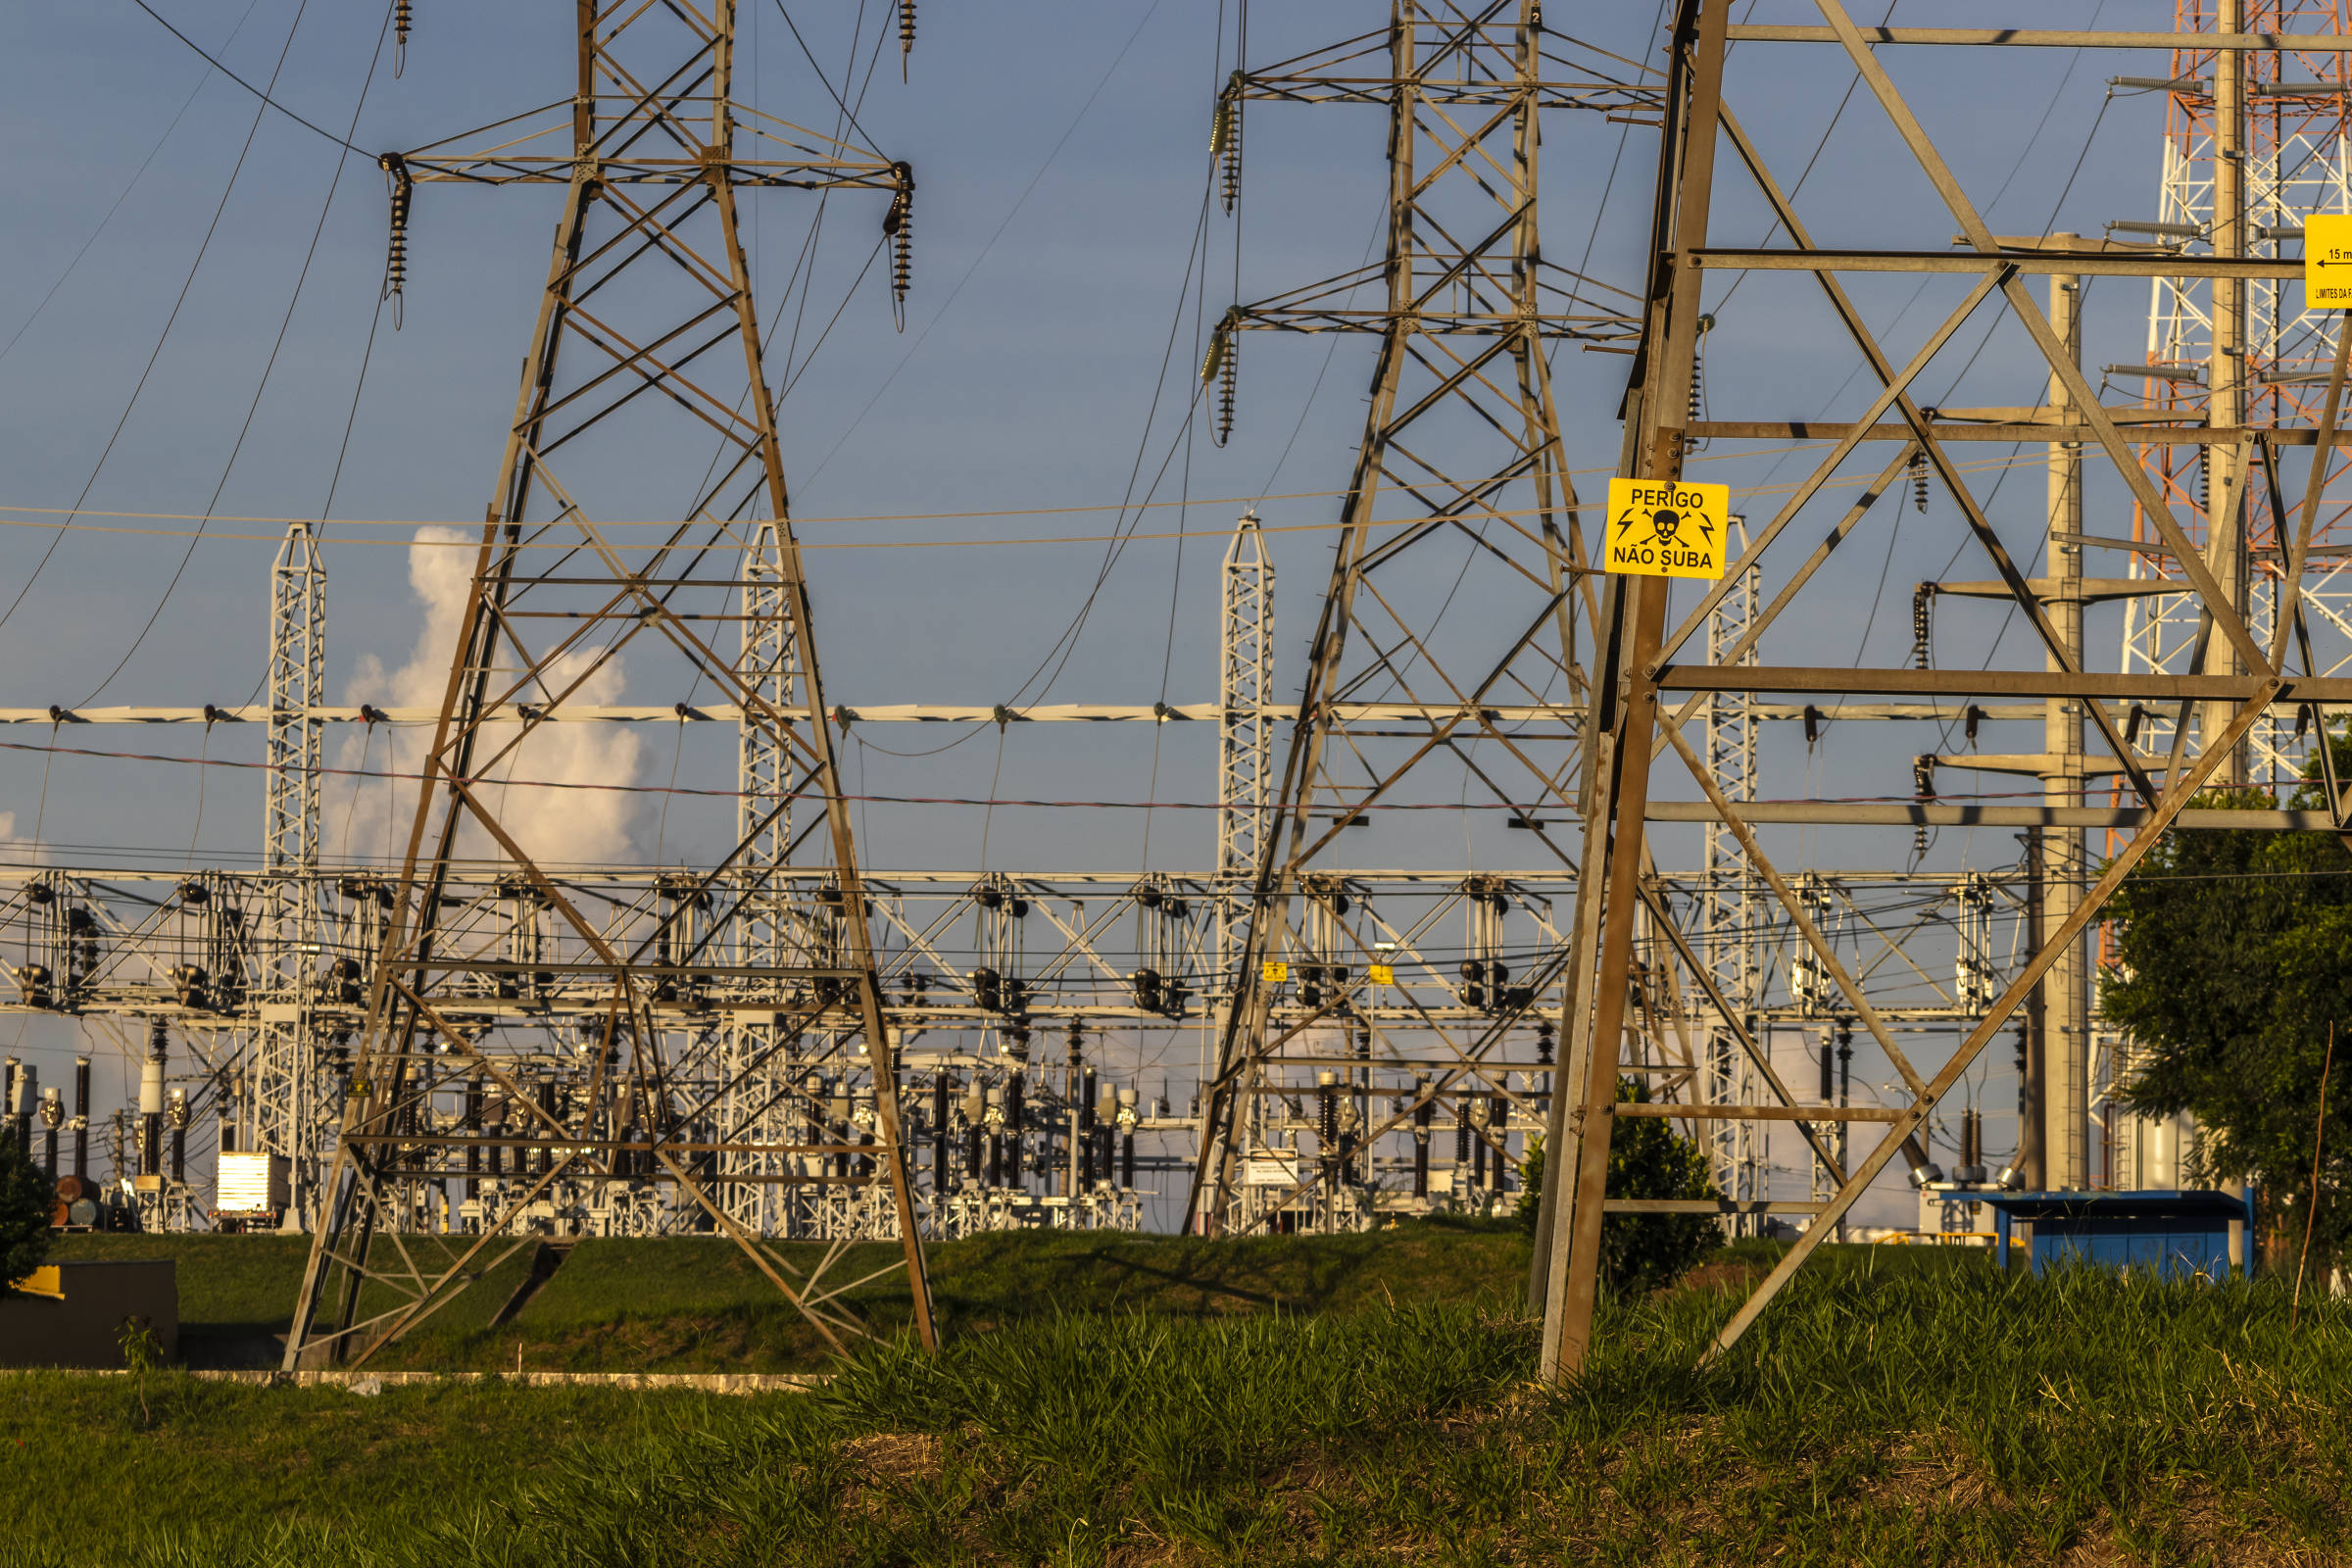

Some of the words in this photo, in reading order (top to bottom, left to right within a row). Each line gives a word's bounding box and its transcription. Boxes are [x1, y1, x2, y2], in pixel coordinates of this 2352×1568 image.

[1532, 12, 1540, 24] 2
[2329, 249, 2340, 259] 15
[2316, 288, 2338, 298] LIMITES
[2339, 288, 2347, 298] DA
[1632, 488, 1703, 509] PERIGO
[1614, 543, 1654, 564] NÃO
[1660, 550, 1713, 568] SUBA
